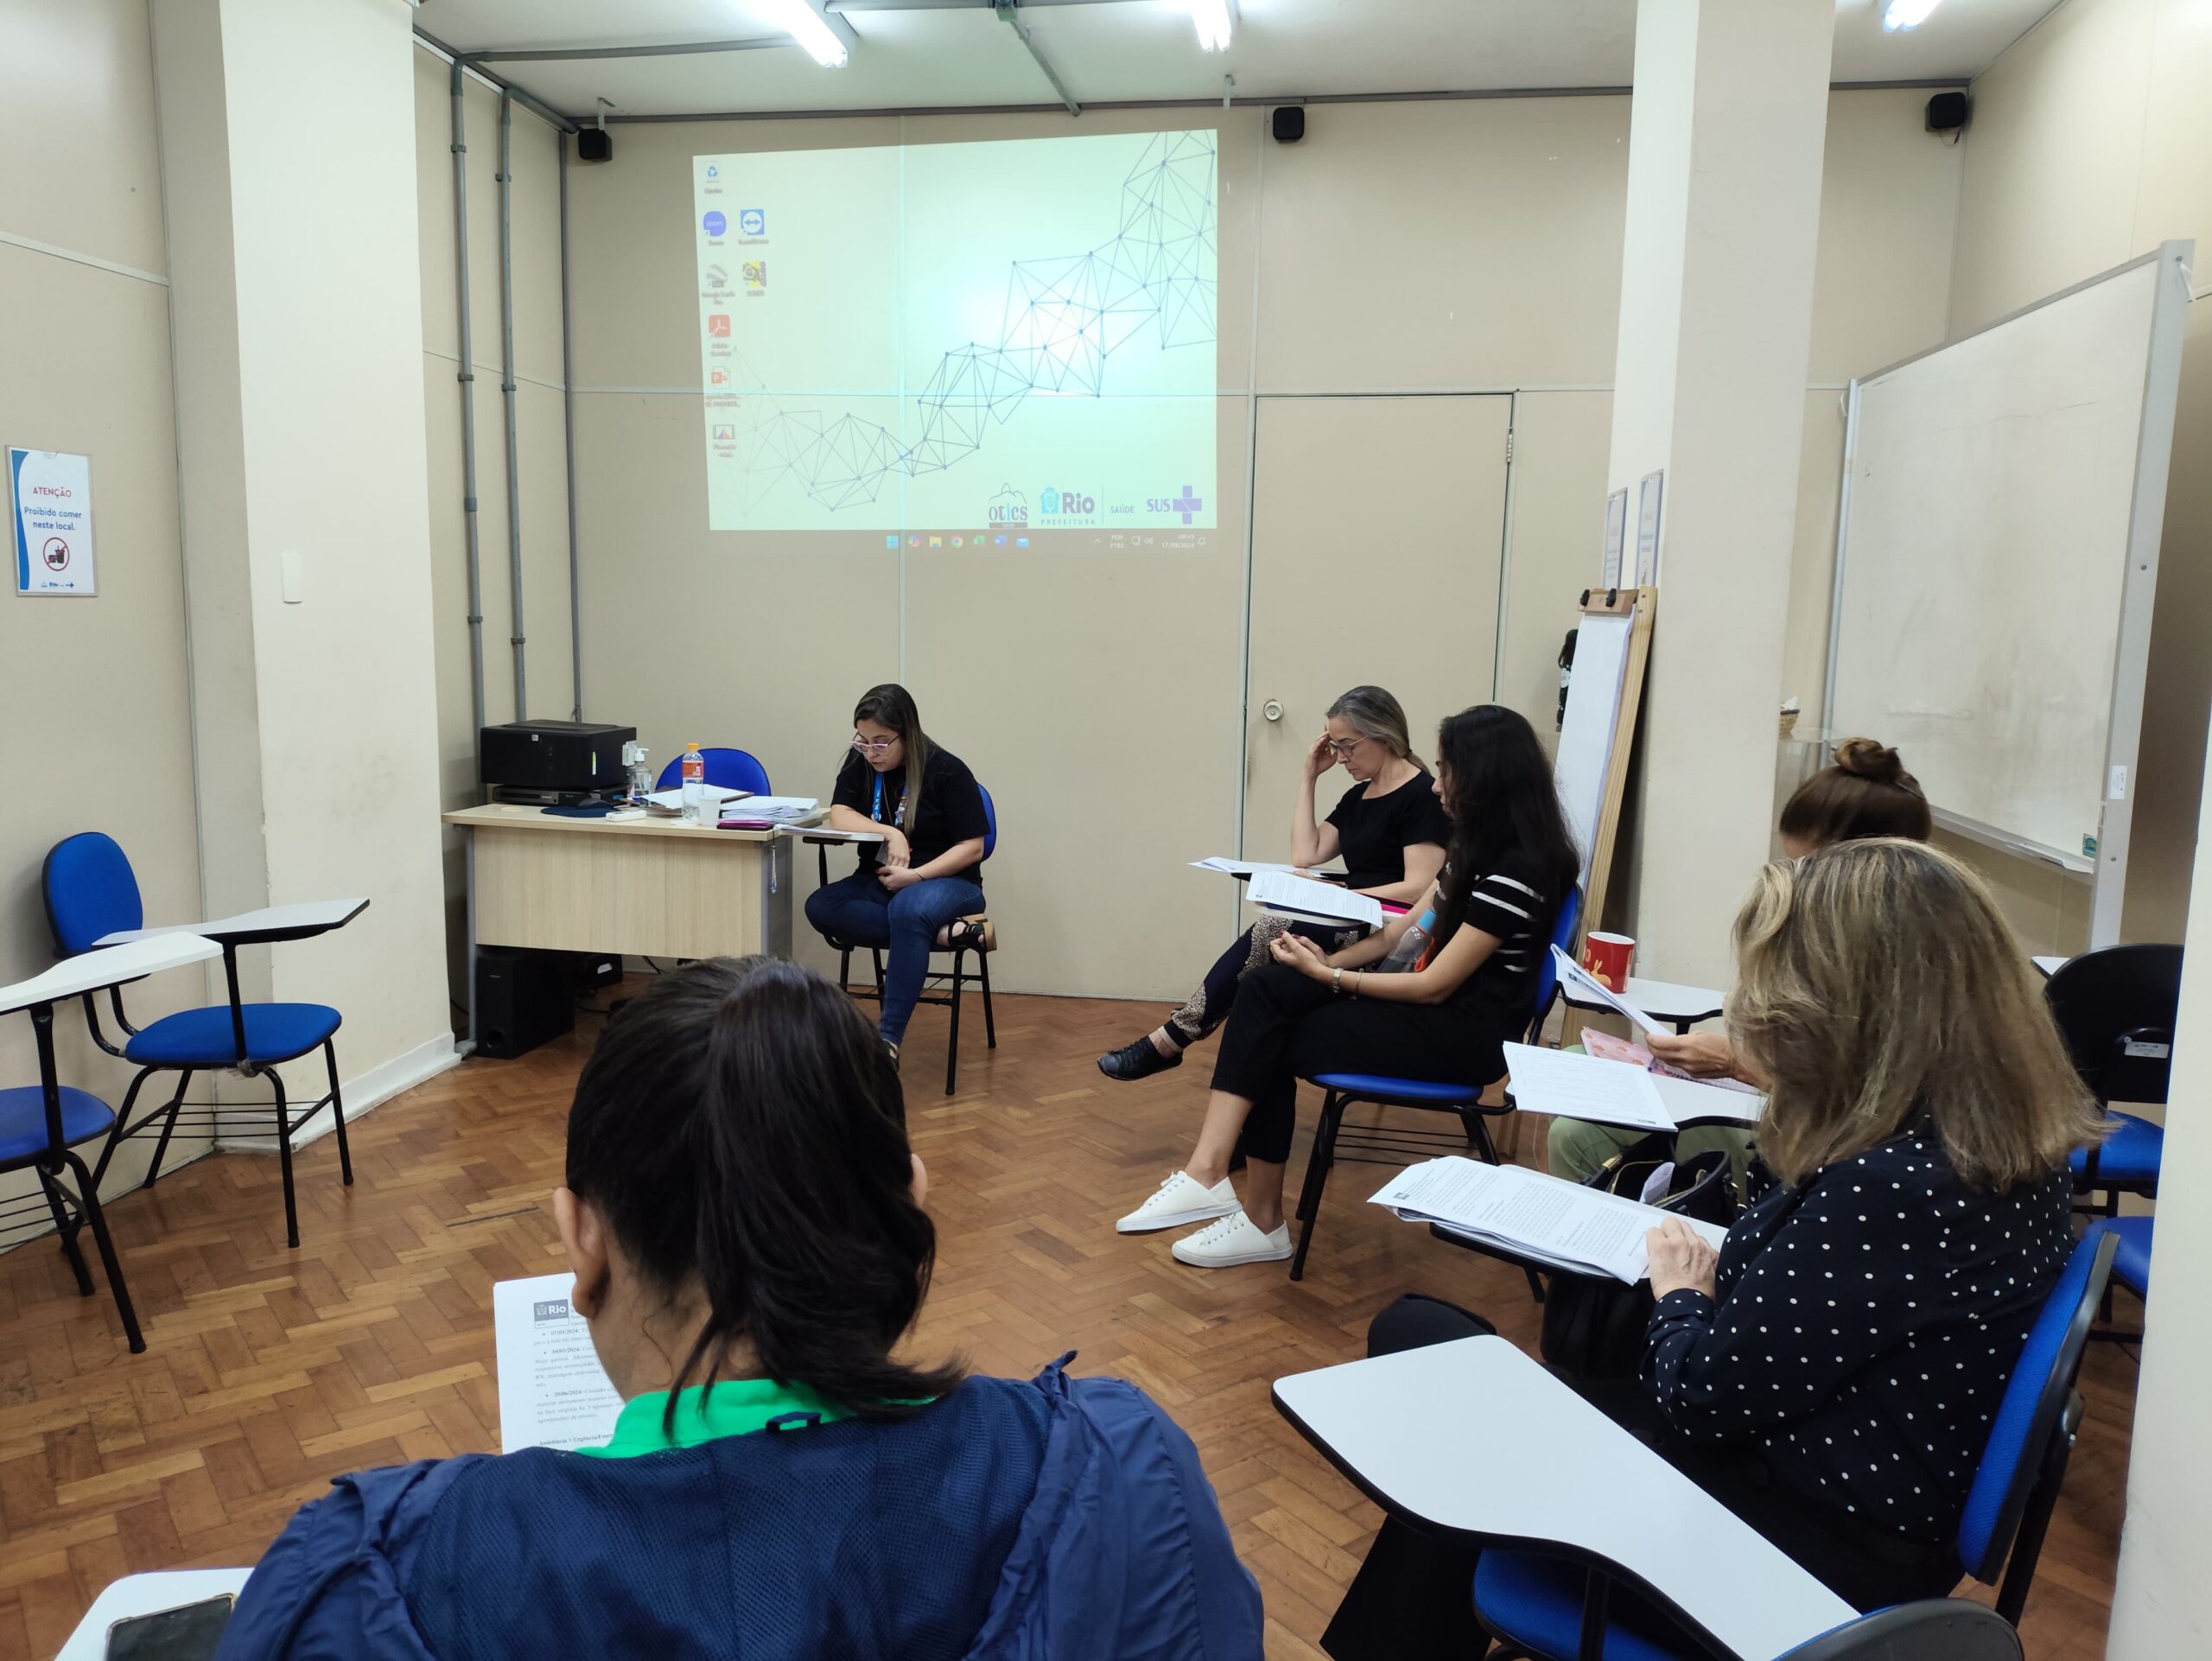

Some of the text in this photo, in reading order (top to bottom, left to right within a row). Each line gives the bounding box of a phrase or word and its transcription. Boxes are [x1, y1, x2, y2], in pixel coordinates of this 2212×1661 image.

[33, 487, 72, 498] ATENÇÃO
[1062, 492, 1171, 513] Rio SAÚDE SUS
[24, 506, 57, 517] Proibido
[988, 503, 1028, 521] otics
[33, 521, 76, 531] neste local.
[548, 1304, 567, 1314] Rio
